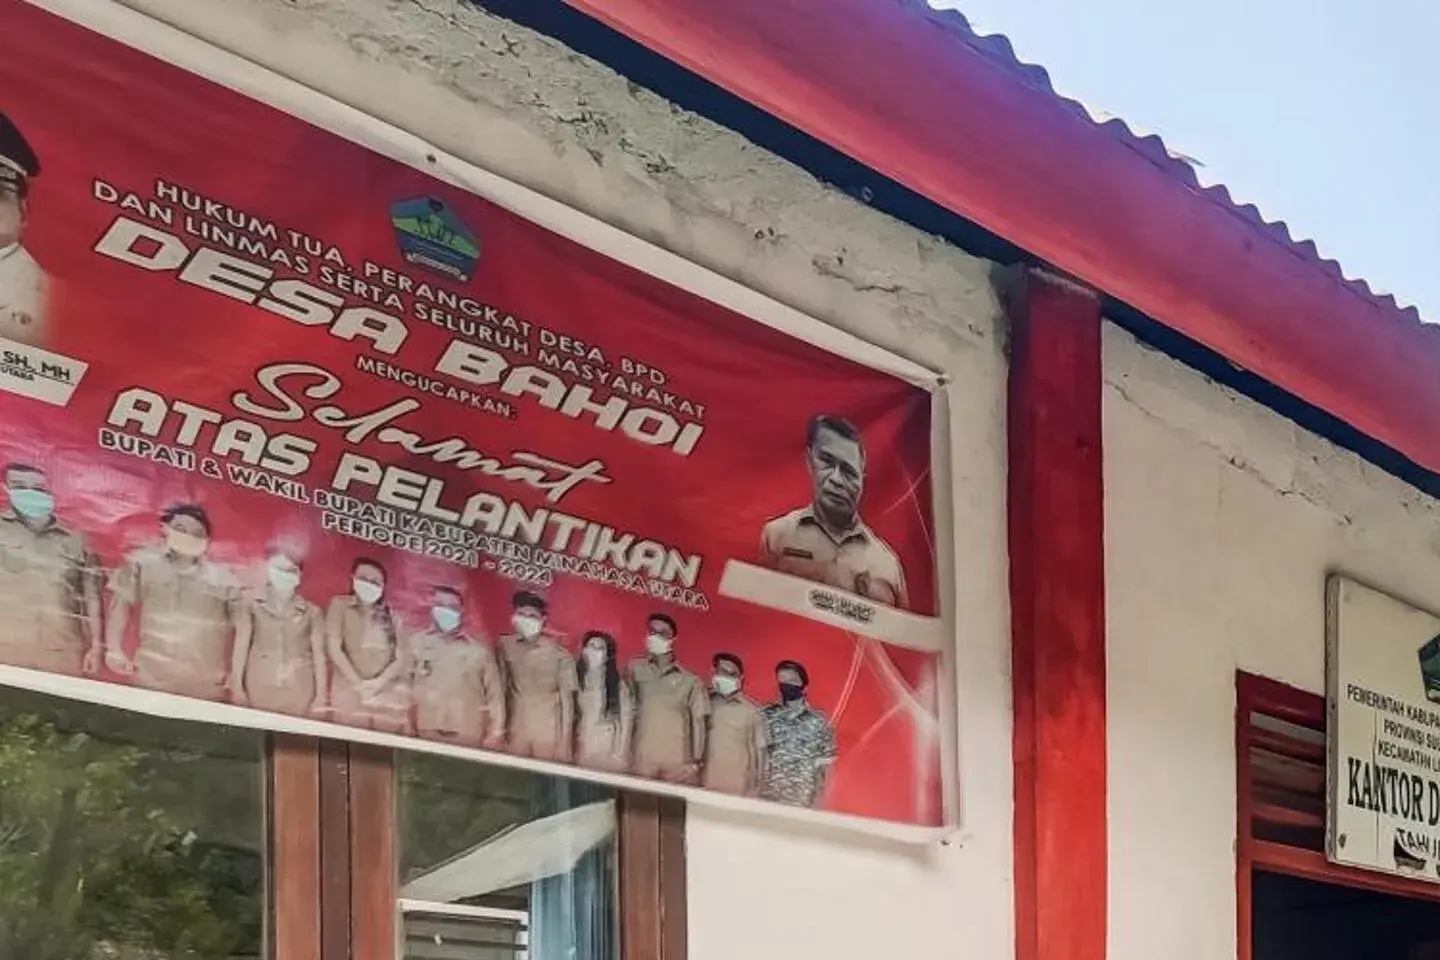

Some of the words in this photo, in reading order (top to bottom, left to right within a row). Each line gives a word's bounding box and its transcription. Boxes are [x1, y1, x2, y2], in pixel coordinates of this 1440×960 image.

[94, 179, 173, 226] DAN
[185, 215, 310, 275] LINMAS
[320, 264, 405, 312] SERTA
[414, 301, 530, 356] SELURUH
[537, 349, 706, 420] MASYARAKAT
[155, 179, 278, 241] HUKUM
[363, 260, 533, 337] PERANGKAT
[621, 357, 666, 385] BPD
[41, 361, 70, 381] MH
[94, 215, 409, 355] DESA
[434, 338, 704, 457] BAHOI
[232, 363, 613, 503] Selamat
[99, 427, 195, 472] BUPATI
[201, 457, 223, 479] &
[227, 463, 310, 504] WAKIL
[314, 488, 395, 528] BUPATI
[401, 513, 531, 562] KABUPATEN
[535, 549, 648, 594] MINAHASA
[650, 579, 709, 611] UTARA
[106, 387, 319, 476] ATAS
[332, 451, 703, 588] PELANTIKAN
[322, 510, 424, 554] PERIODE
[427, 539, 478, 568] 2021
[1346, 684, 1405, 717] PEMERINTAH
[1383, 718, 1426, 746] PROVINSI
[1346, 756, 1424, 823] KANTOR
[1377, 738, 1432, 772] KECAMATAN
